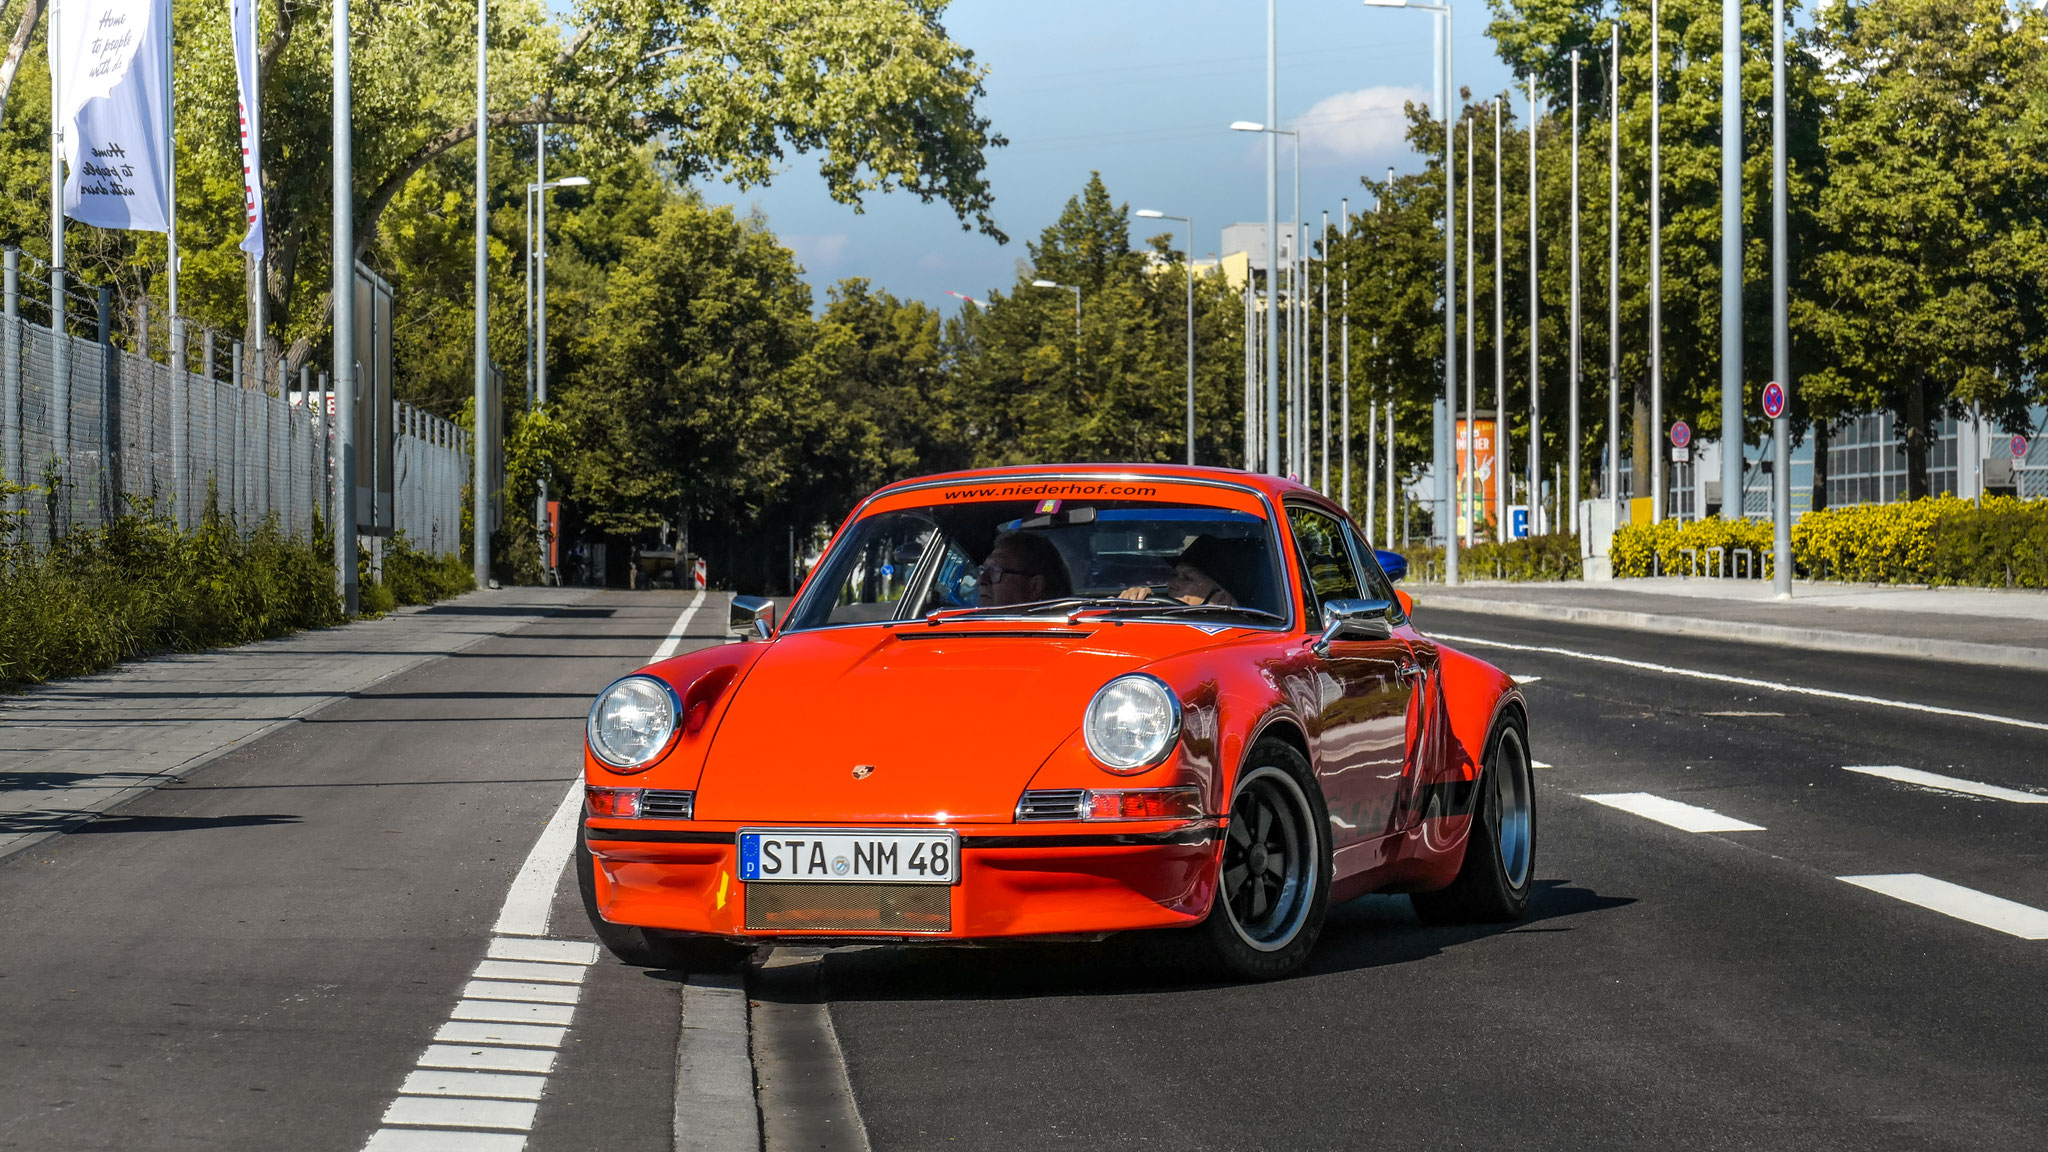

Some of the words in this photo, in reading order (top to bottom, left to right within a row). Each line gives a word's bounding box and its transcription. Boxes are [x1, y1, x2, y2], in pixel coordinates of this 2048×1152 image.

[99, 8, 126, 30] Home
[91, 37, 103, 54] to
[100, 29, 132, 60] people
[89, 57, 111, 78] with
[945, 484, 1156, 499] www.niederhof.com
[747, 862, 755, 872] D
[762, 840, 828, 875] STA
[854, 841, 898, 875] NM
[908, 842, 949, 876] 48
